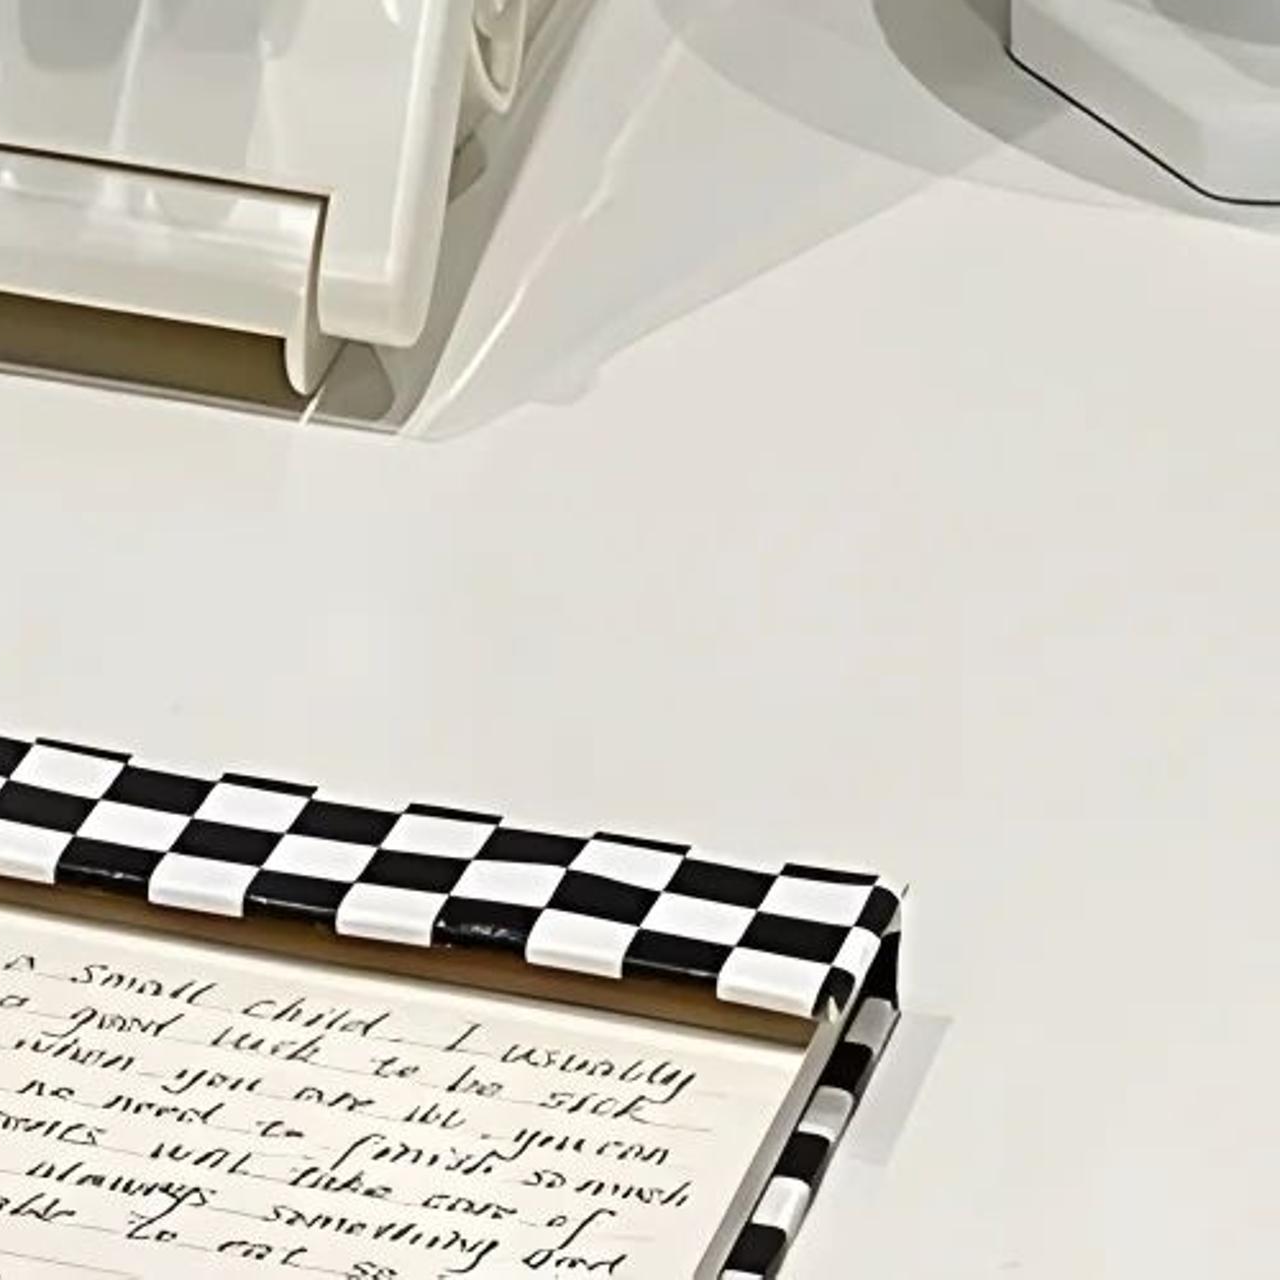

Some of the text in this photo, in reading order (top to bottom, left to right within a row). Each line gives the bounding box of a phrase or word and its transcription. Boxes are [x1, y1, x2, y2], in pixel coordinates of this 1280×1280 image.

[69, 963, 217, 1005] small
[373, 1056, 420, 1079] to
[545, 1207, 617, 1251] of
